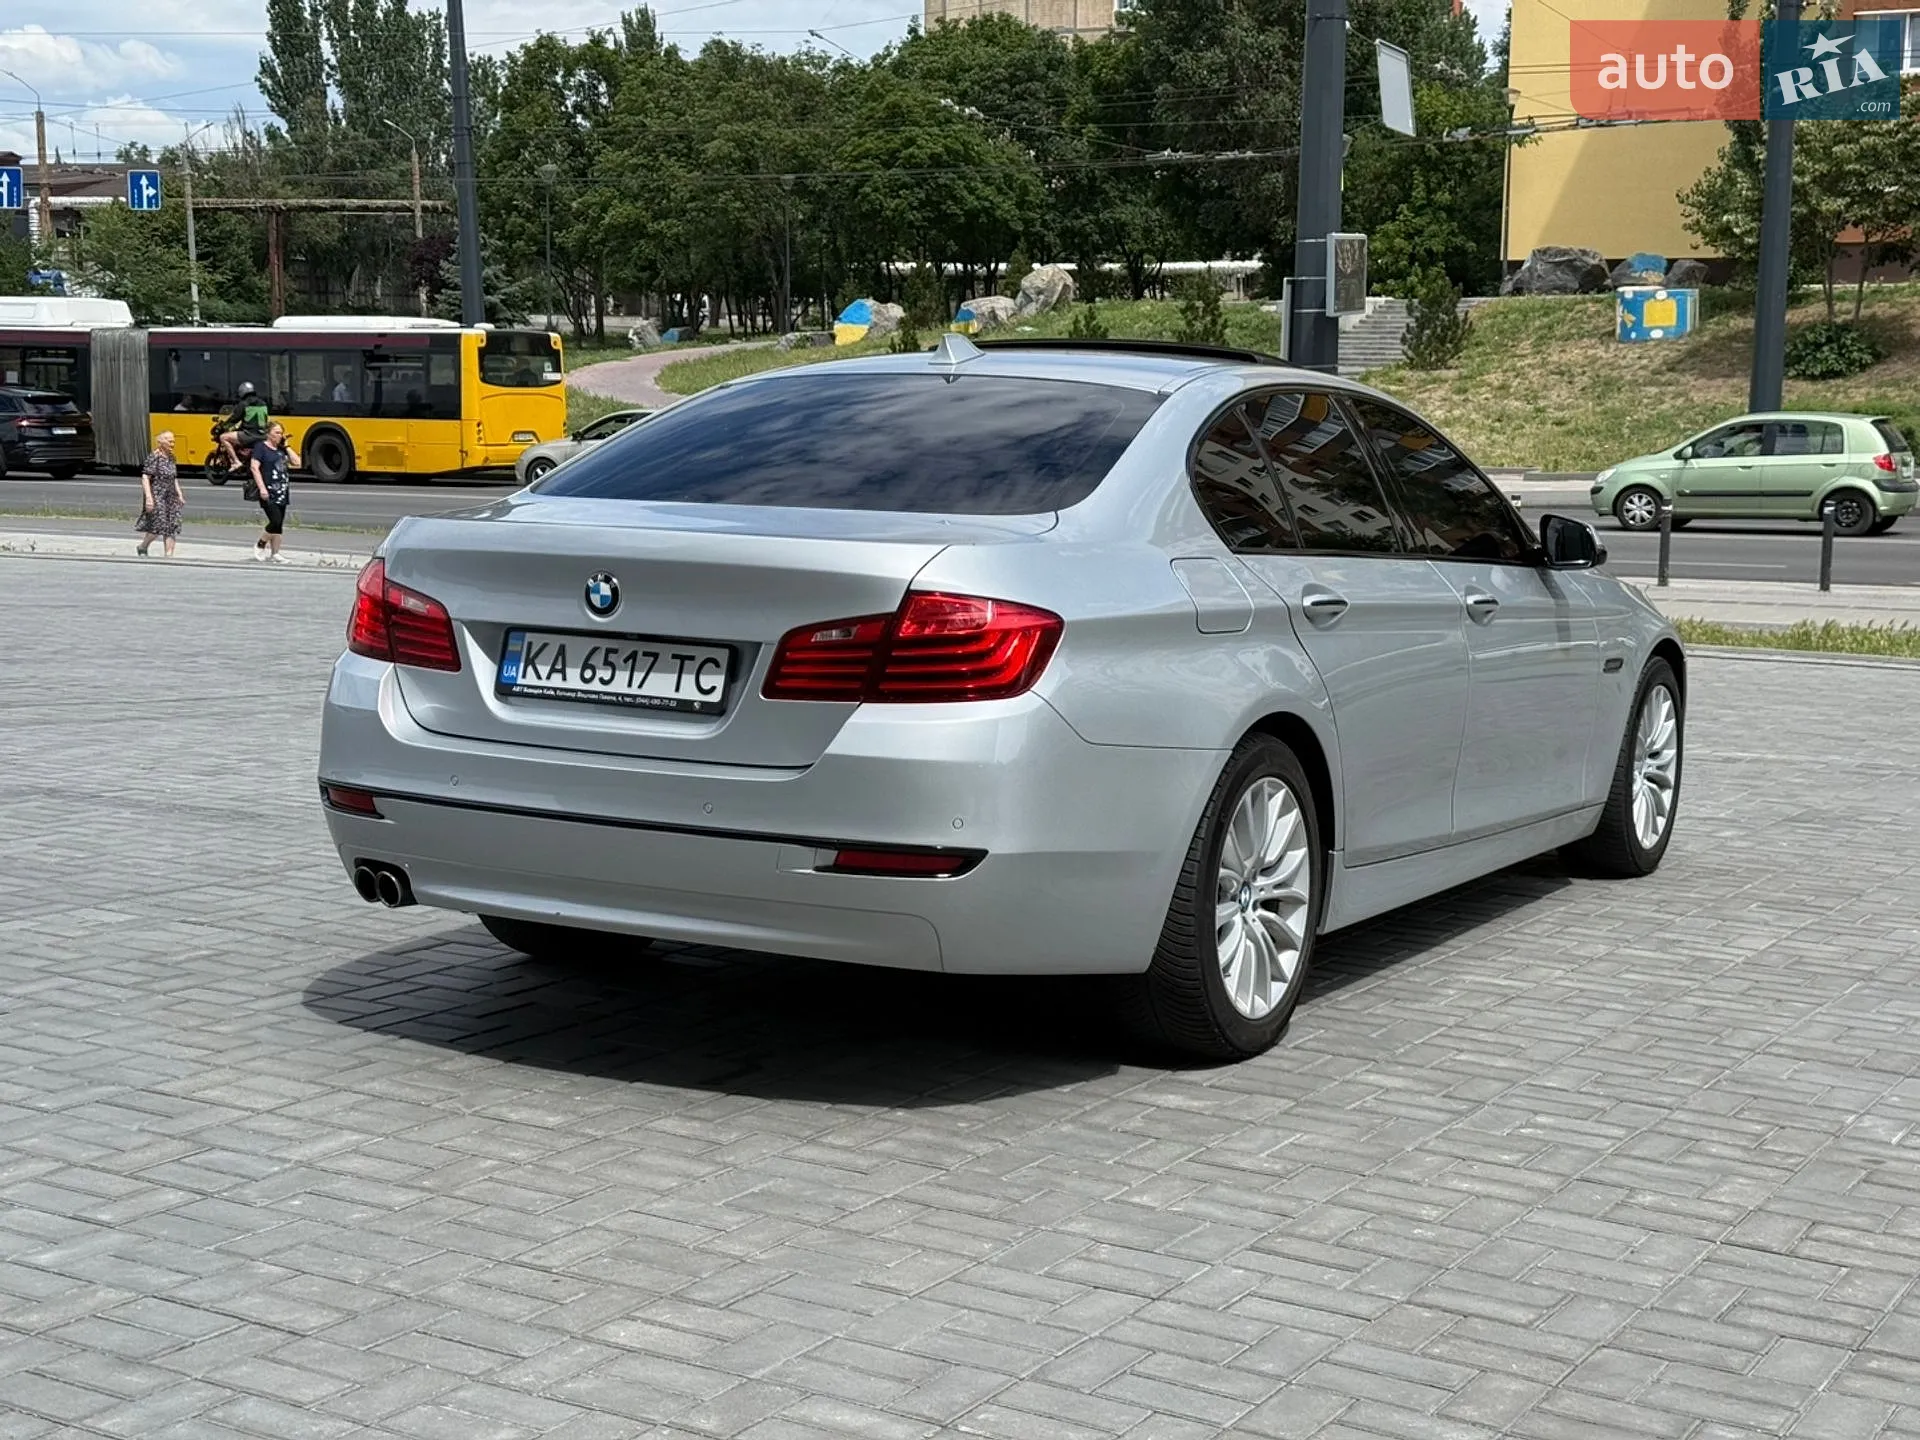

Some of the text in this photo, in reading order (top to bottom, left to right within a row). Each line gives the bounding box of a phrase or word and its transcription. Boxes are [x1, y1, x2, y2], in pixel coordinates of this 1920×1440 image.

[503, 664, 517, 677] UA
[522, 641, 721, 696] KA 6517 TC
